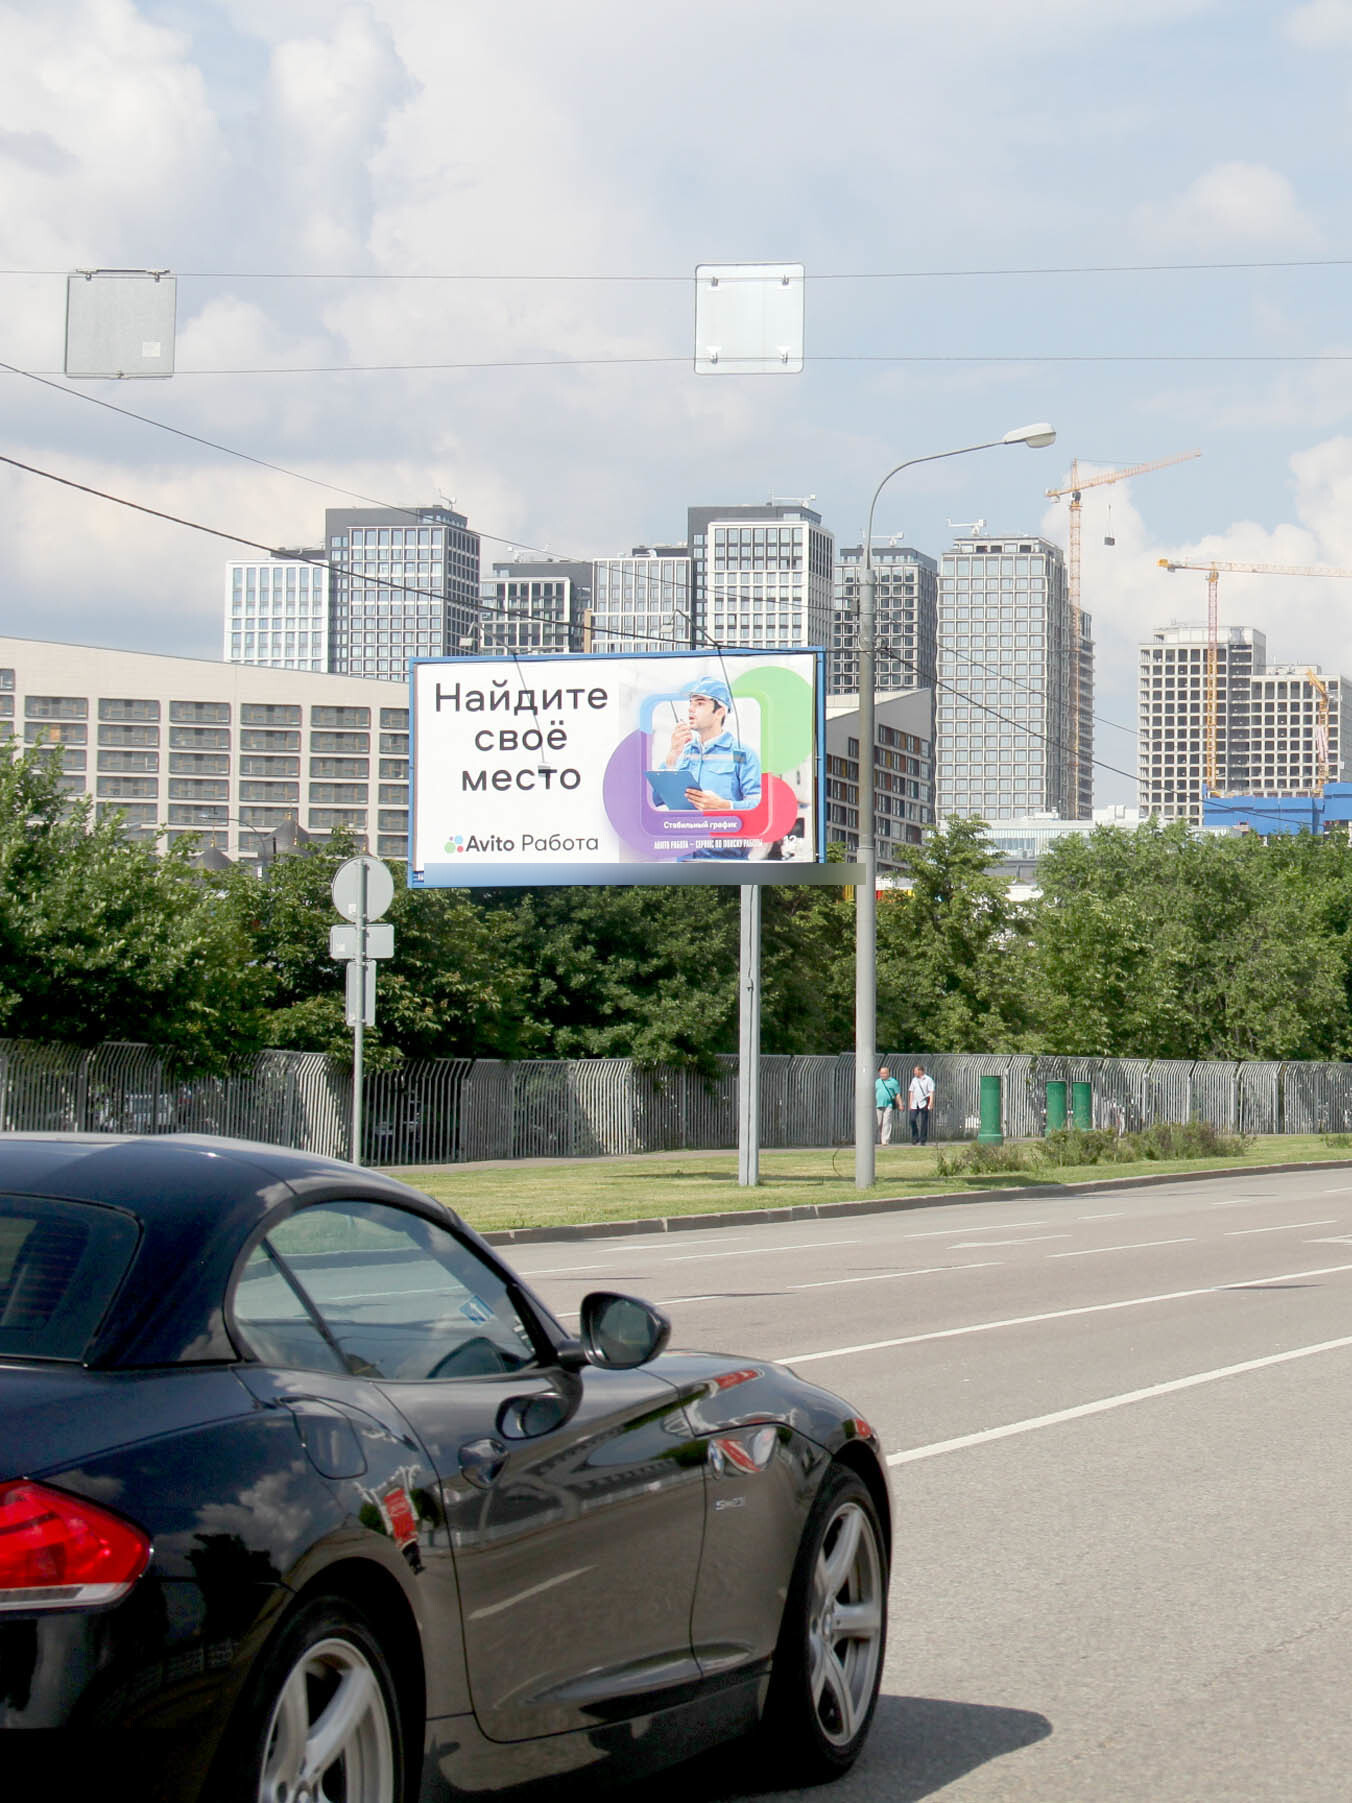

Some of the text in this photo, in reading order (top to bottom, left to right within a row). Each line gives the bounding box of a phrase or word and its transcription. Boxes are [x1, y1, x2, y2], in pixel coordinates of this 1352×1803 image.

[435, 679, 608, 716] Найдите
[474, 719, 568, 752] своё
[462, 767, 581, 792] место
[466, 833, 599, 852] Avito Работа
